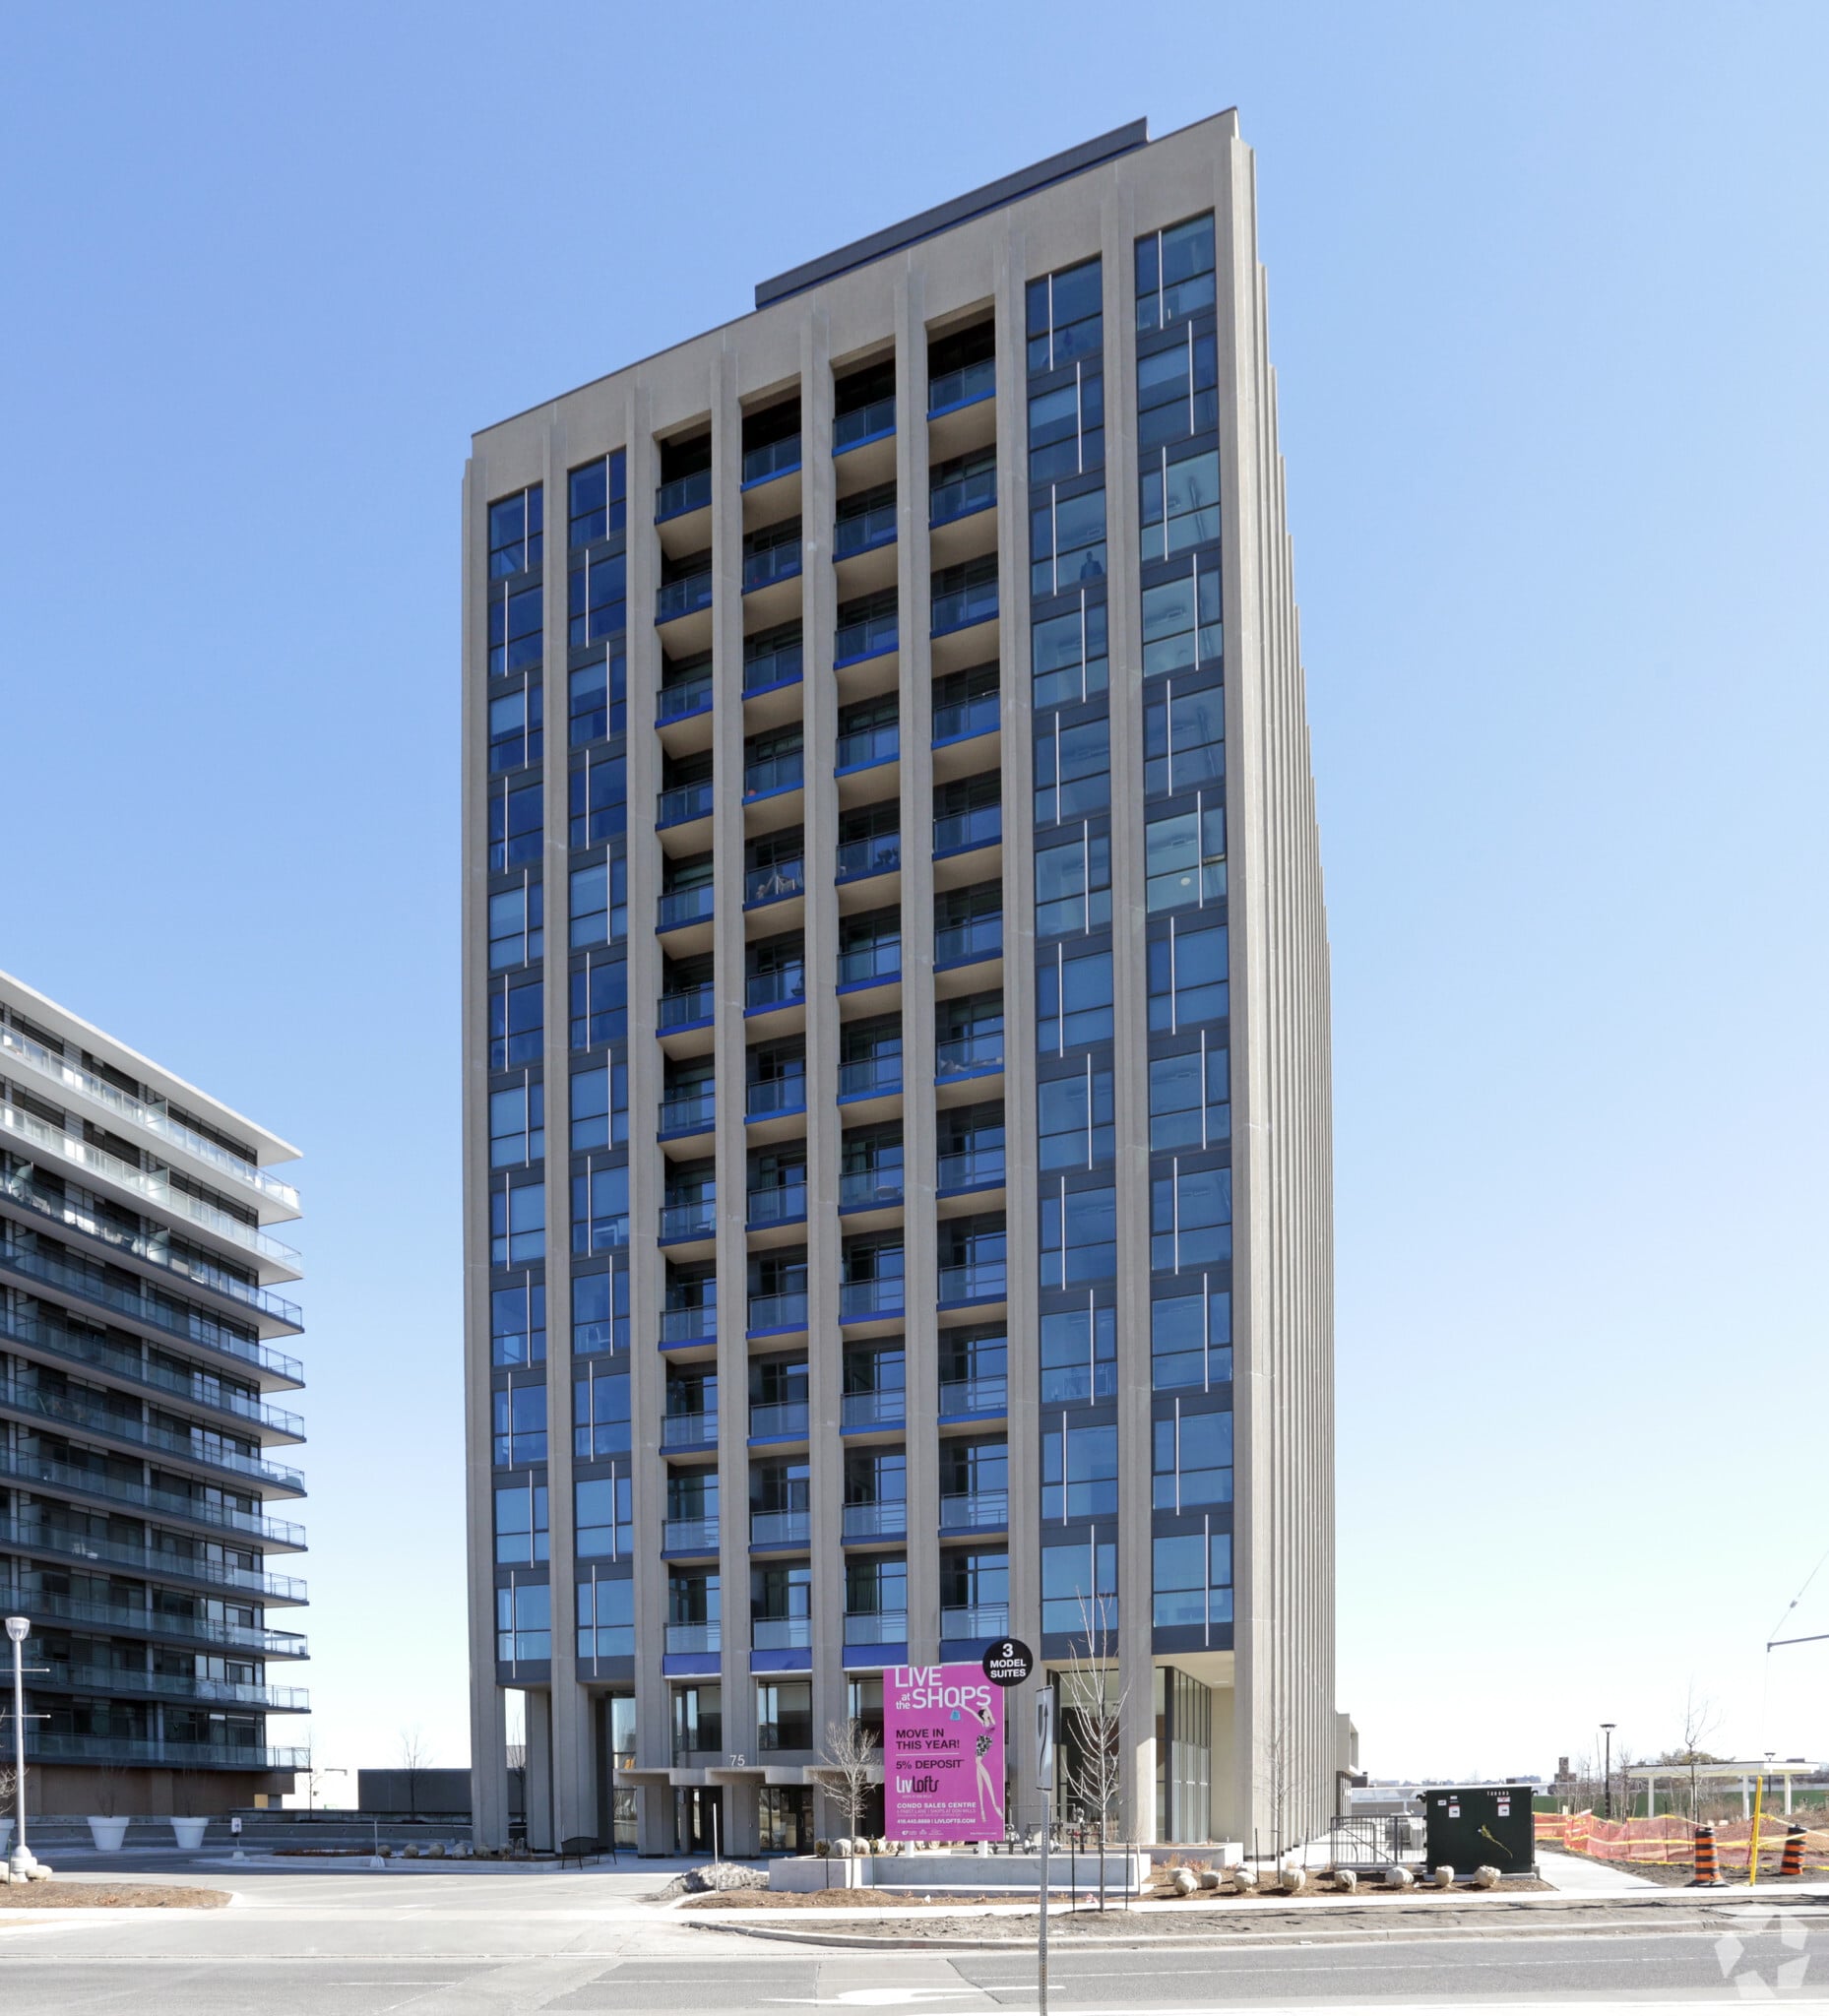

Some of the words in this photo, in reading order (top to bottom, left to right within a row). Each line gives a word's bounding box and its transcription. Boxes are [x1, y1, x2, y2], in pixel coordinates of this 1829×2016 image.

[1002, 1643, 1014, 1658] 3
[989, 1659, 1027, 1669] MODEL
[895, 1666, 943, 1687] LIVE
[990, 1669, 1026, 1678] SUITES
[901, 1692, 911, 1702] at
[912, 1685, 992, 1710] SHOPS
[896, 1701, 911, 1710] the
[896, 1729, 929, 1739] MOVE
[932, 1728, 945, 1738] IN
[896, 1740, 922, 1750] THIS
[925, 1739, 960, 1749] YEAR!
[729, 1754, 745, 1767] 75
[896, 1761, 913, 1770] 5%
